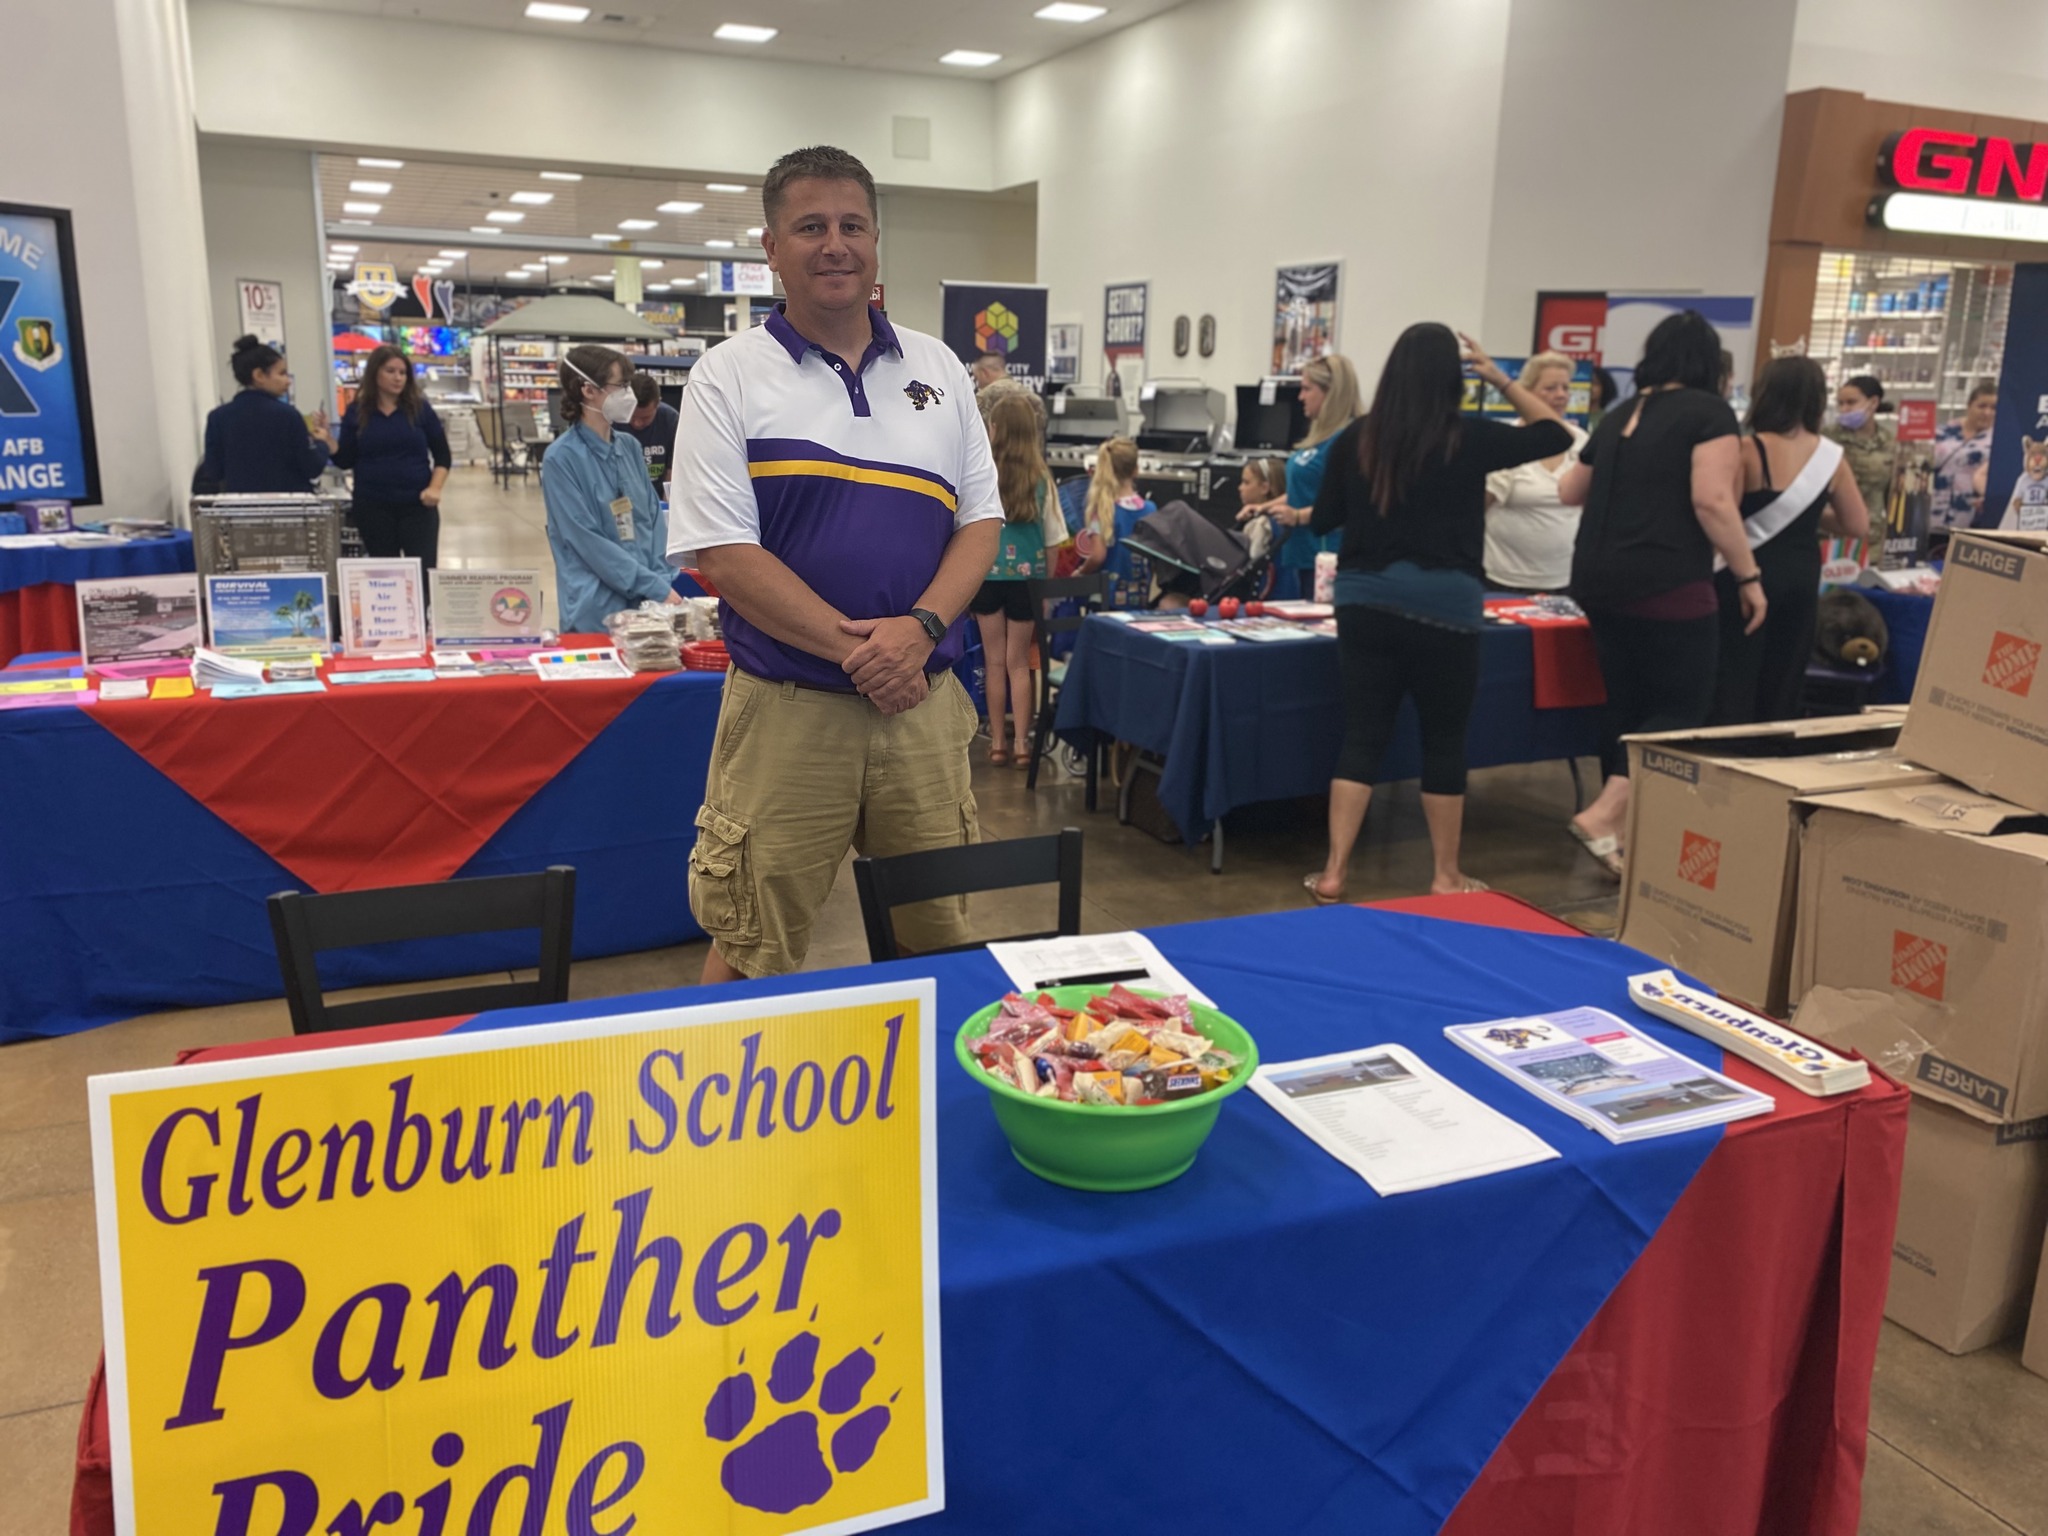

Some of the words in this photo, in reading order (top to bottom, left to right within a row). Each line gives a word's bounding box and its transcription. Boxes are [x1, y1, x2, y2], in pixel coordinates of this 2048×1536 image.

[1892, 126, 2048, 202] GN
[1005, 363, 1030, 375] CITY
[3, 438, 44, 457] AFB
[644, 445, 665, 456] BIRD
[0, 463, 65, 490] NGE
[1959, 544, 2018, 575] LARGE
[215, 581, 268, 589] SURVIVAL
[1985, 643, 2040, 686] HOME
[1645, 753, 1693, 778] LARGE
[1679, 841, 1719, 878] HOME
[1892, 942, 1946, 986] HOME
[1926, 1061, 2001, 1107] LARGE
[141, 1076, 594, 1224] Glenburn
[629, 1014, 904, 1154] School
[164, 1188, 841, 1430] Panther
